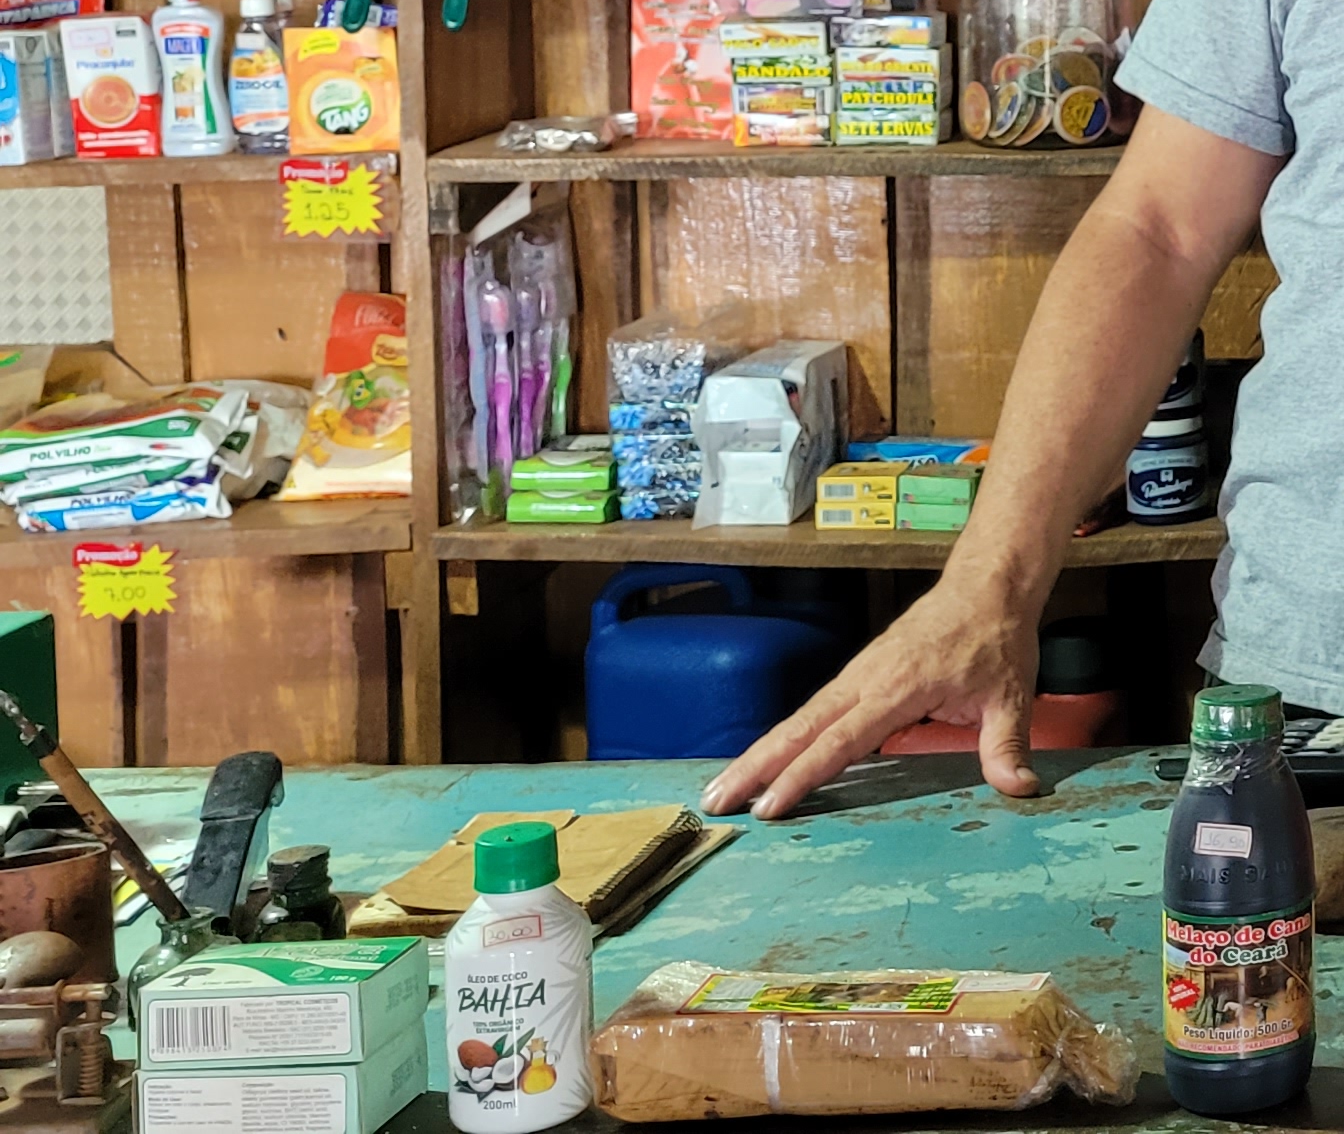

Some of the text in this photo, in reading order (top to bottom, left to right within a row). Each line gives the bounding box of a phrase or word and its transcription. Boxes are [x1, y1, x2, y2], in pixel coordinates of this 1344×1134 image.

[842, 91, 935, 105] PATCHOULI
[320, 106, 370, 130] TANG
[839, 120, 934, 136] SETE ERVAS
[29, 446, 92, 462] POLVILHO
[76, 549, 139, 564] Promoção
[1166, 913, 1312, 950] Melaço de Cana
[1189, 938, 1289, 967] do Ceará
[467, 971, 528, 984] ÓLEO DE COCO
[457, 978, 546, 1018] BAHIA
[1182, 1025, 1206, 1039] Peso
[1256, 1021, 1278, 1036] 500
[483, 1099, 517, 1111] 200ml
